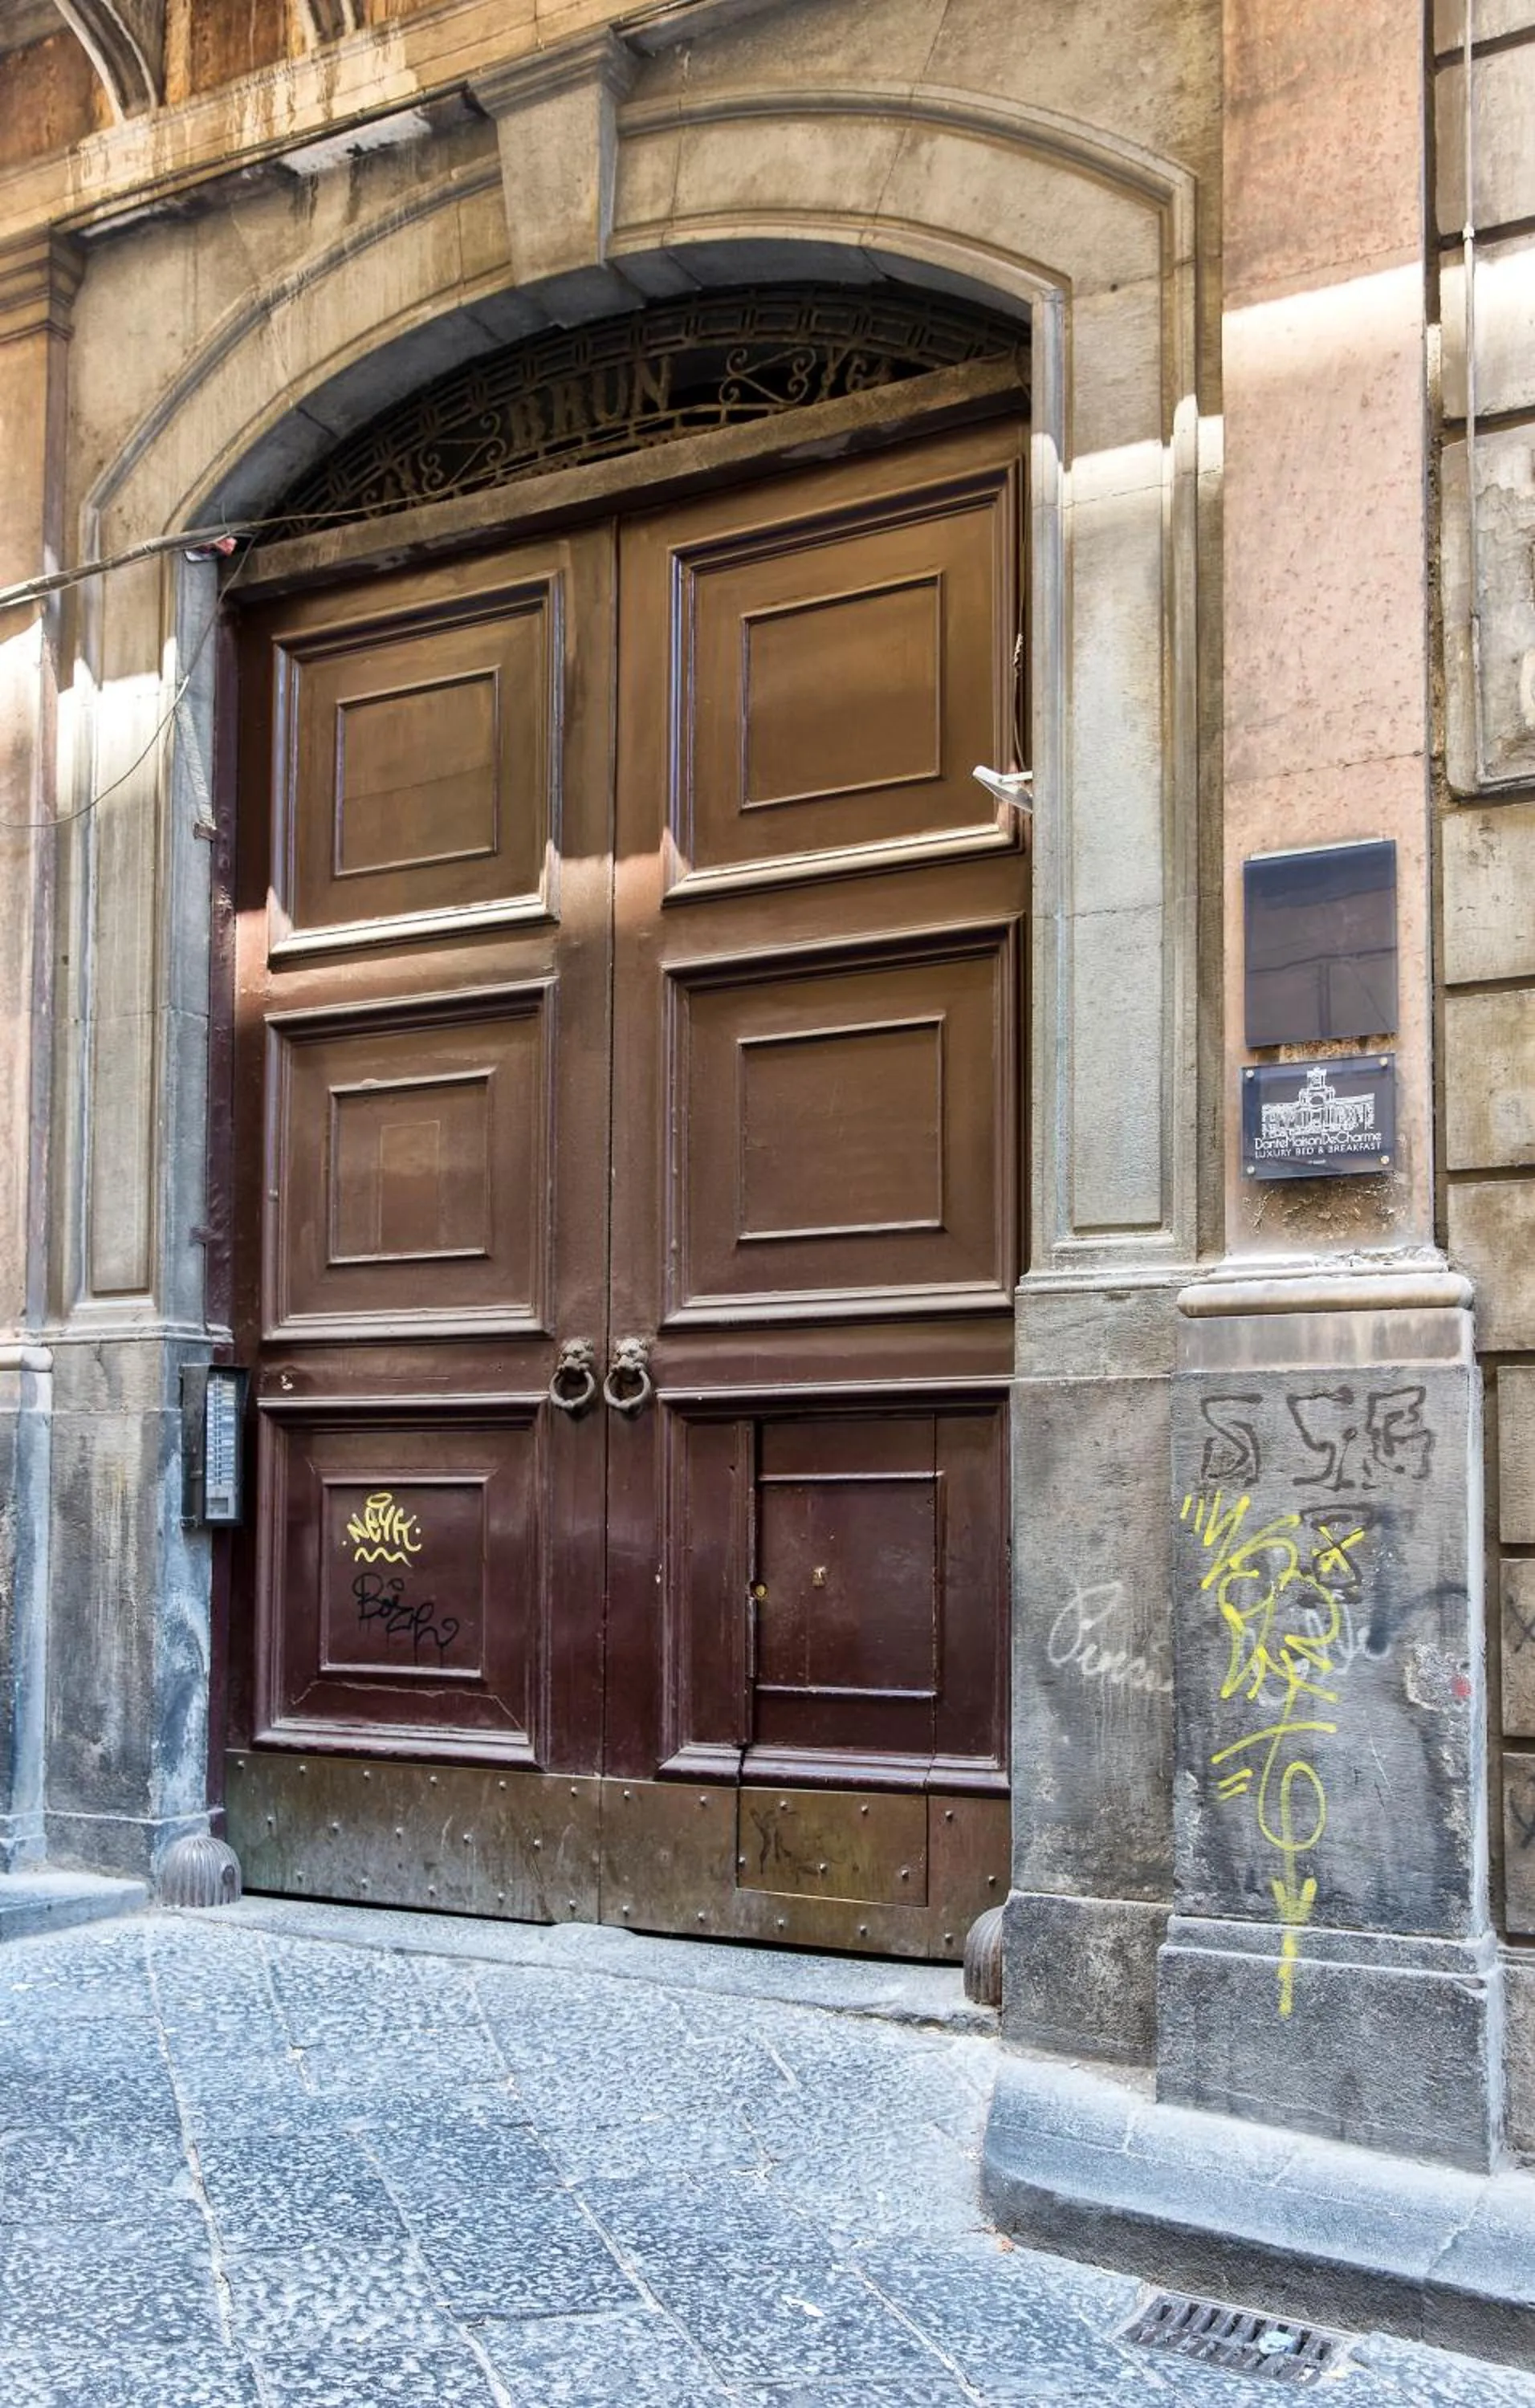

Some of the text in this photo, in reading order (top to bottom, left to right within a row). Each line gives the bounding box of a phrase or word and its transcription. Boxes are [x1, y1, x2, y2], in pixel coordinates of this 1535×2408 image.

[1255, 1142, 1381, 1159] LUXURY BED & BREAKFAST
